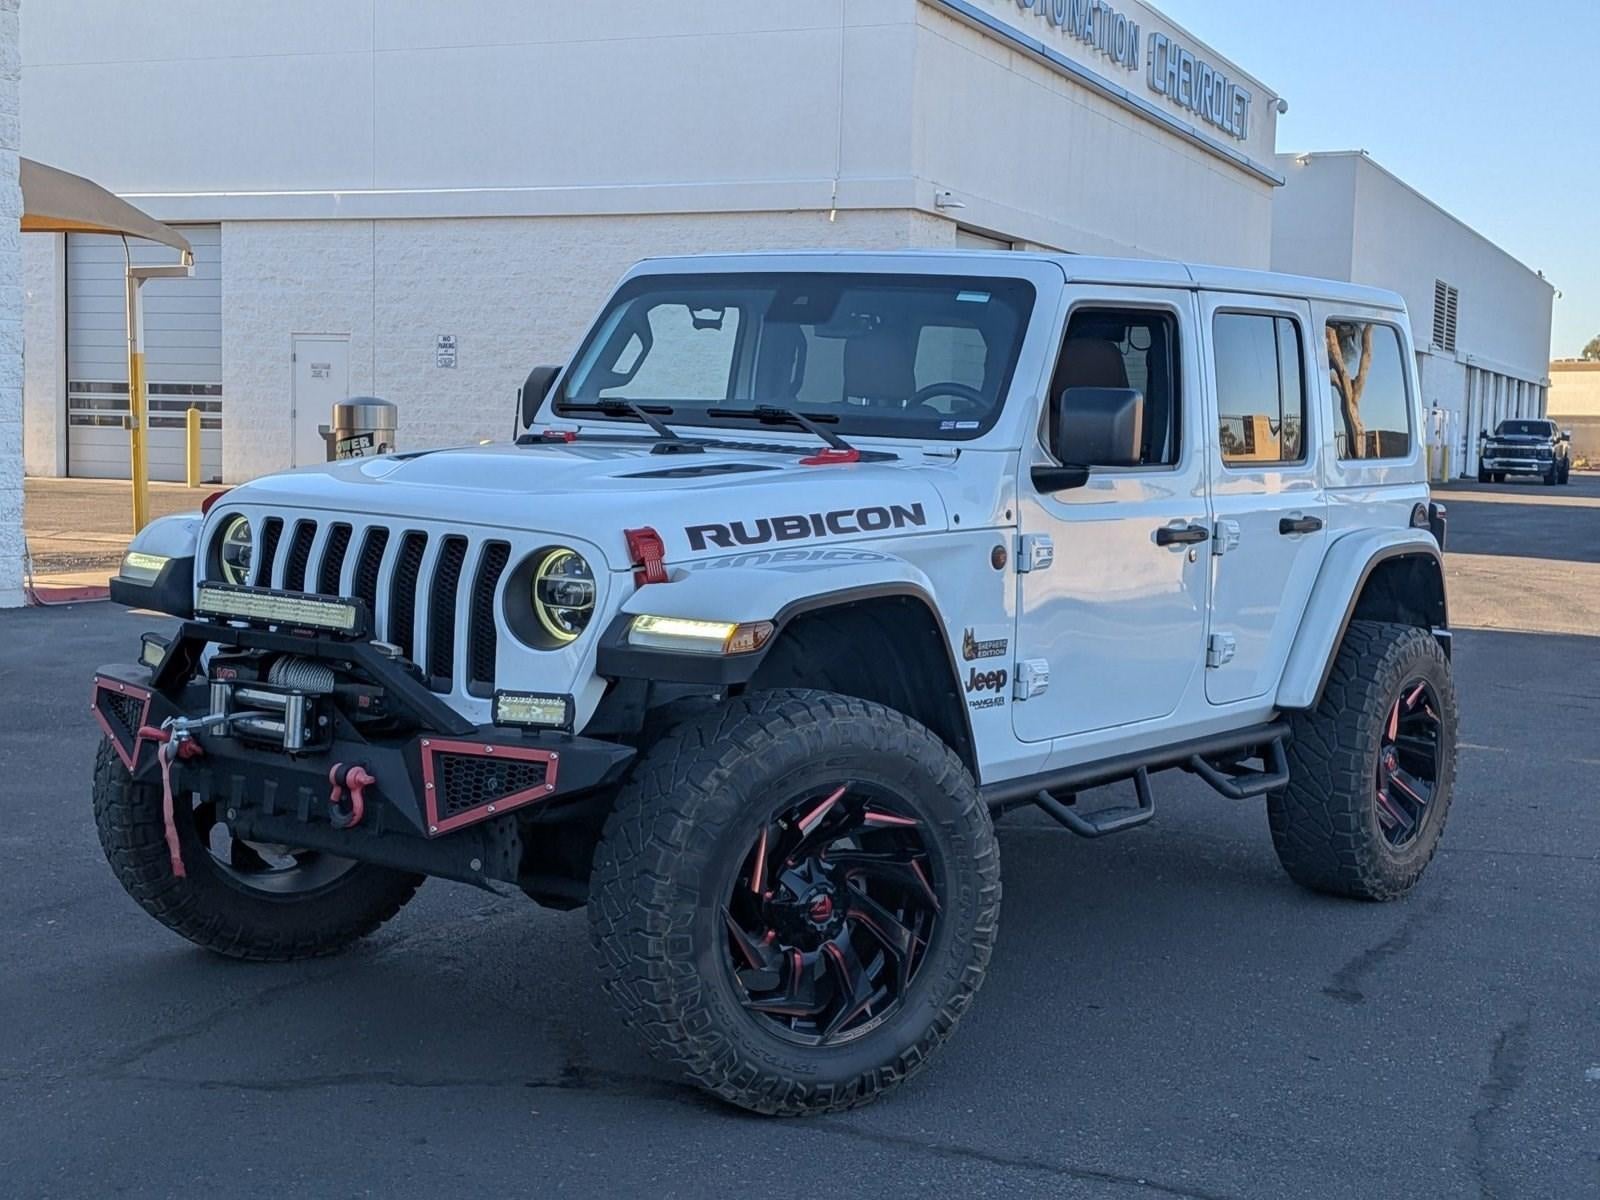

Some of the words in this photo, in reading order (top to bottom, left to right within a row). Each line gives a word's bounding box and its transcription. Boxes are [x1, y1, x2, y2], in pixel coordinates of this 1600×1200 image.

[1016, 0, 1139, 70] ONATION
[1147, 32, 1251, 140] CHEVROLET
[685, 503, 926, 551] RUBICON
[964, 667, 1008, 693] Jeep
[969, 696, 1005, 707] RANGLER
